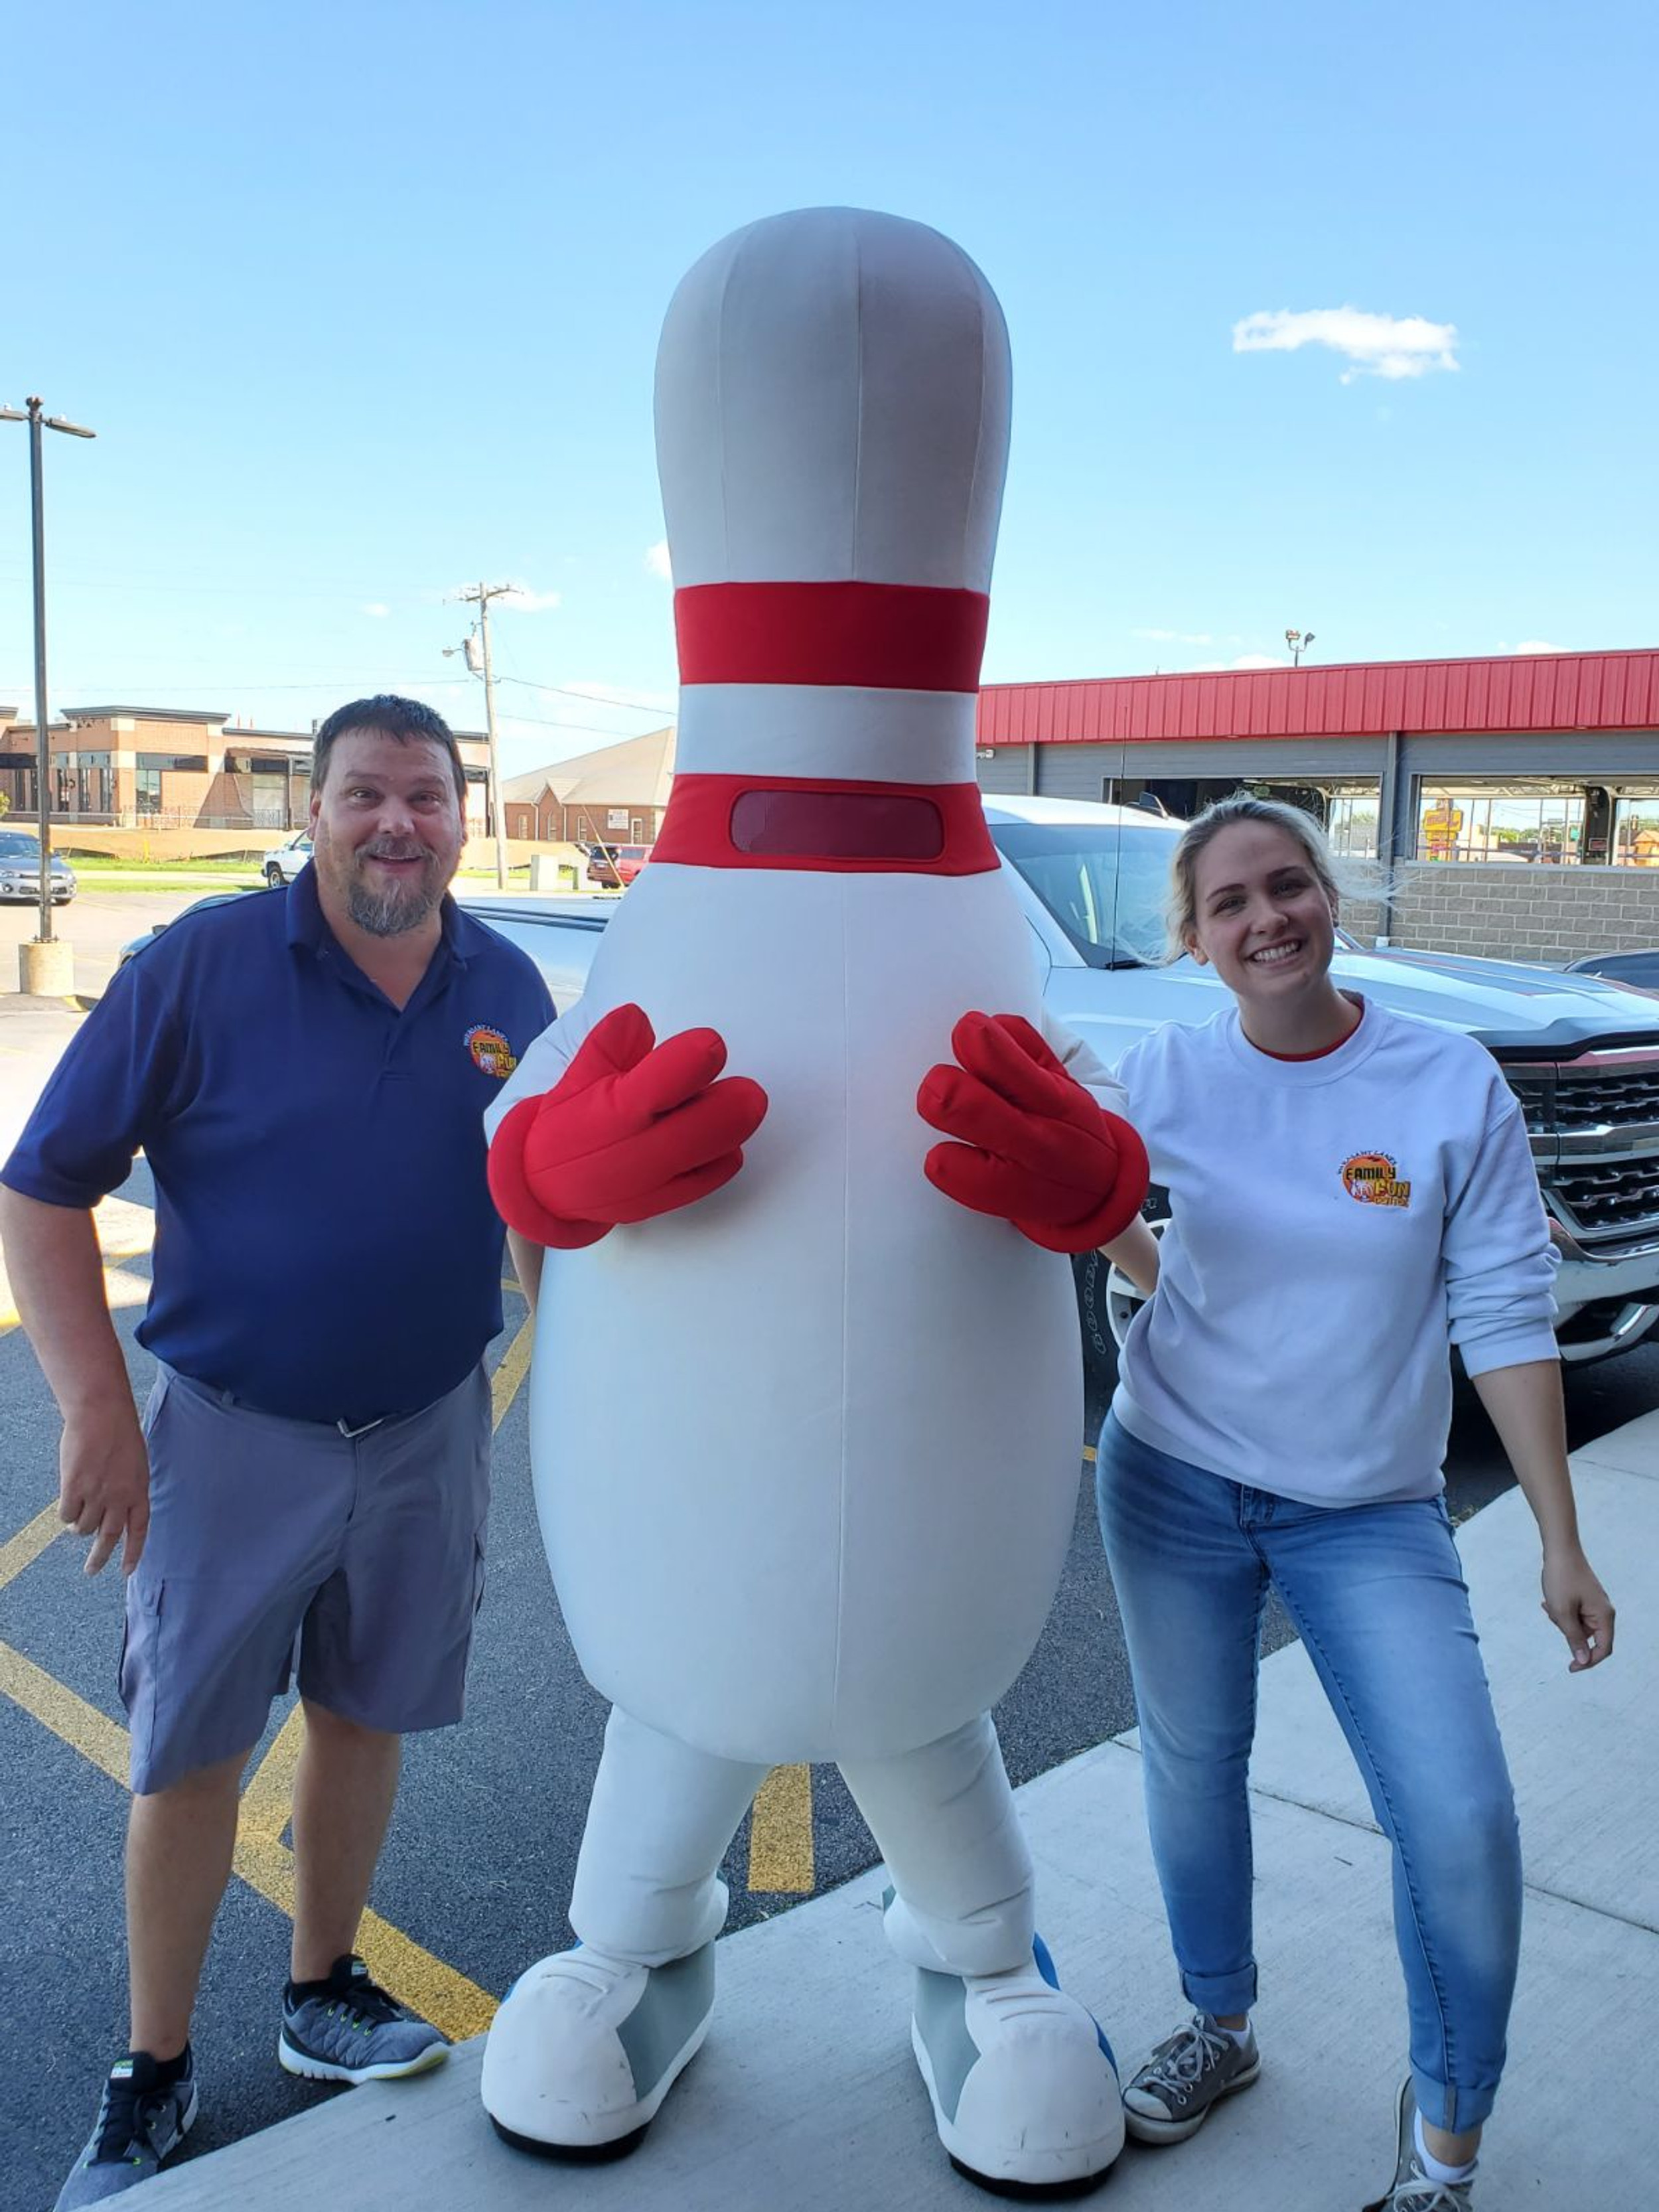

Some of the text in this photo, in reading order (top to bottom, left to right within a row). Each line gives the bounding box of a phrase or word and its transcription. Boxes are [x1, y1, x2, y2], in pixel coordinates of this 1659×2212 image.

[472, 1041, 510, 1055] FAMILY
[1345, 1167, 1396, 1181] FAMILY
[1374, 1179, 1411, 1199] FUN
